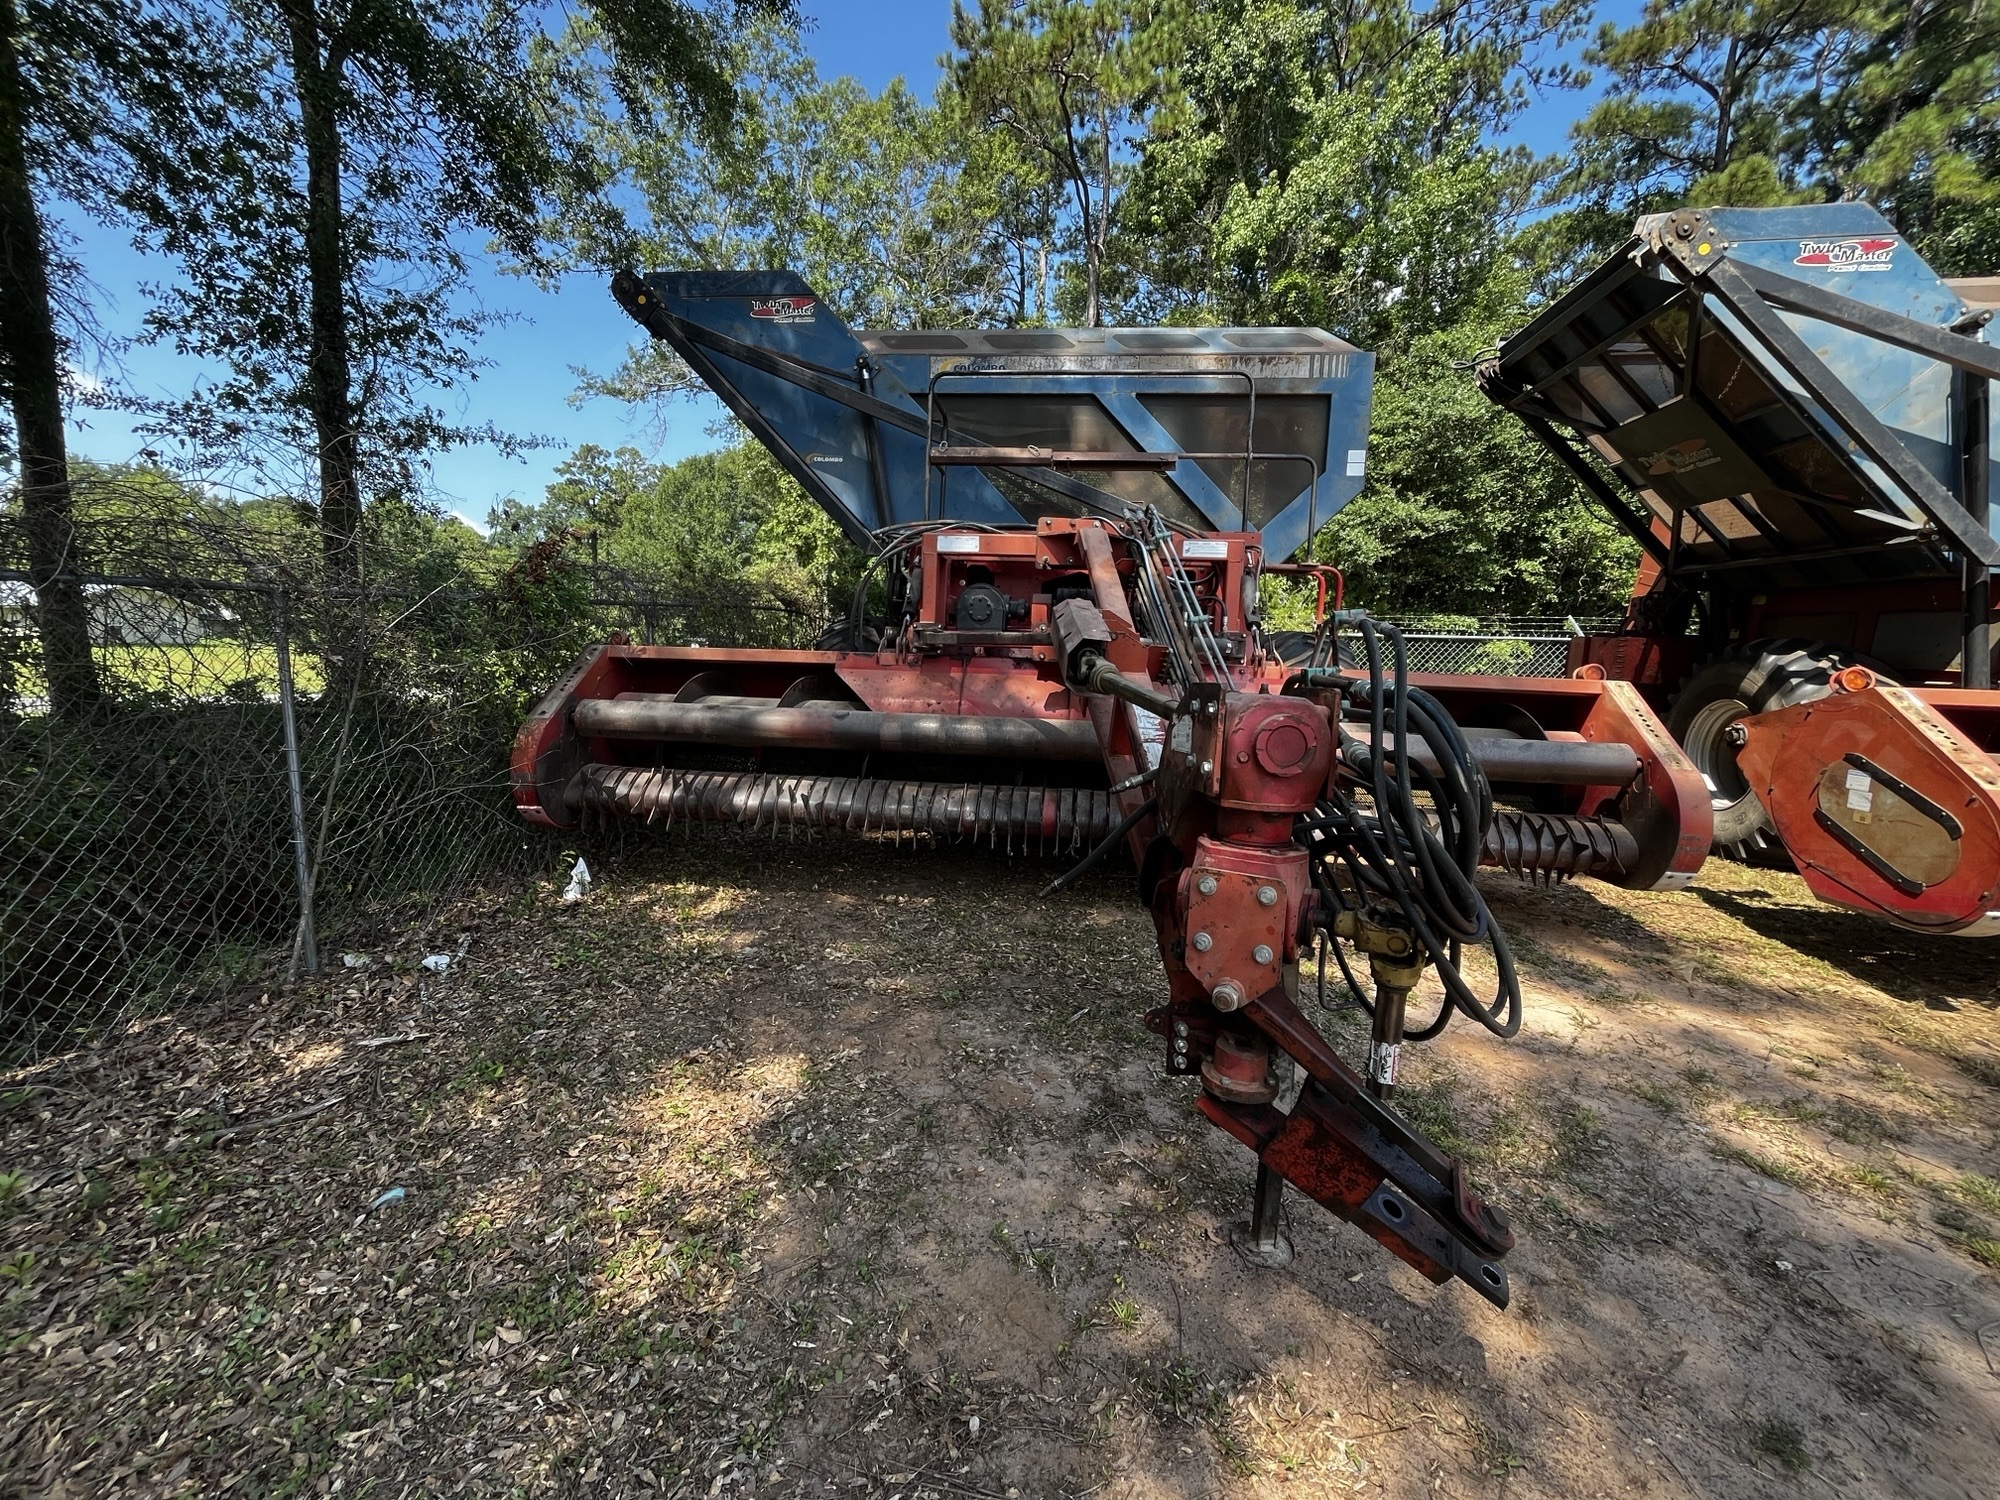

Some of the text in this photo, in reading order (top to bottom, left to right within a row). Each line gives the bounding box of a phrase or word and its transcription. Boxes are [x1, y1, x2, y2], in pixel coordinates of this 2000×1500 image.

[1800, 242, 1842, 255] Twin
[1840, 249, 1891, 262] Master
[751, 300, 780, 310] Twin
[782, 305, 815, 315] Master
